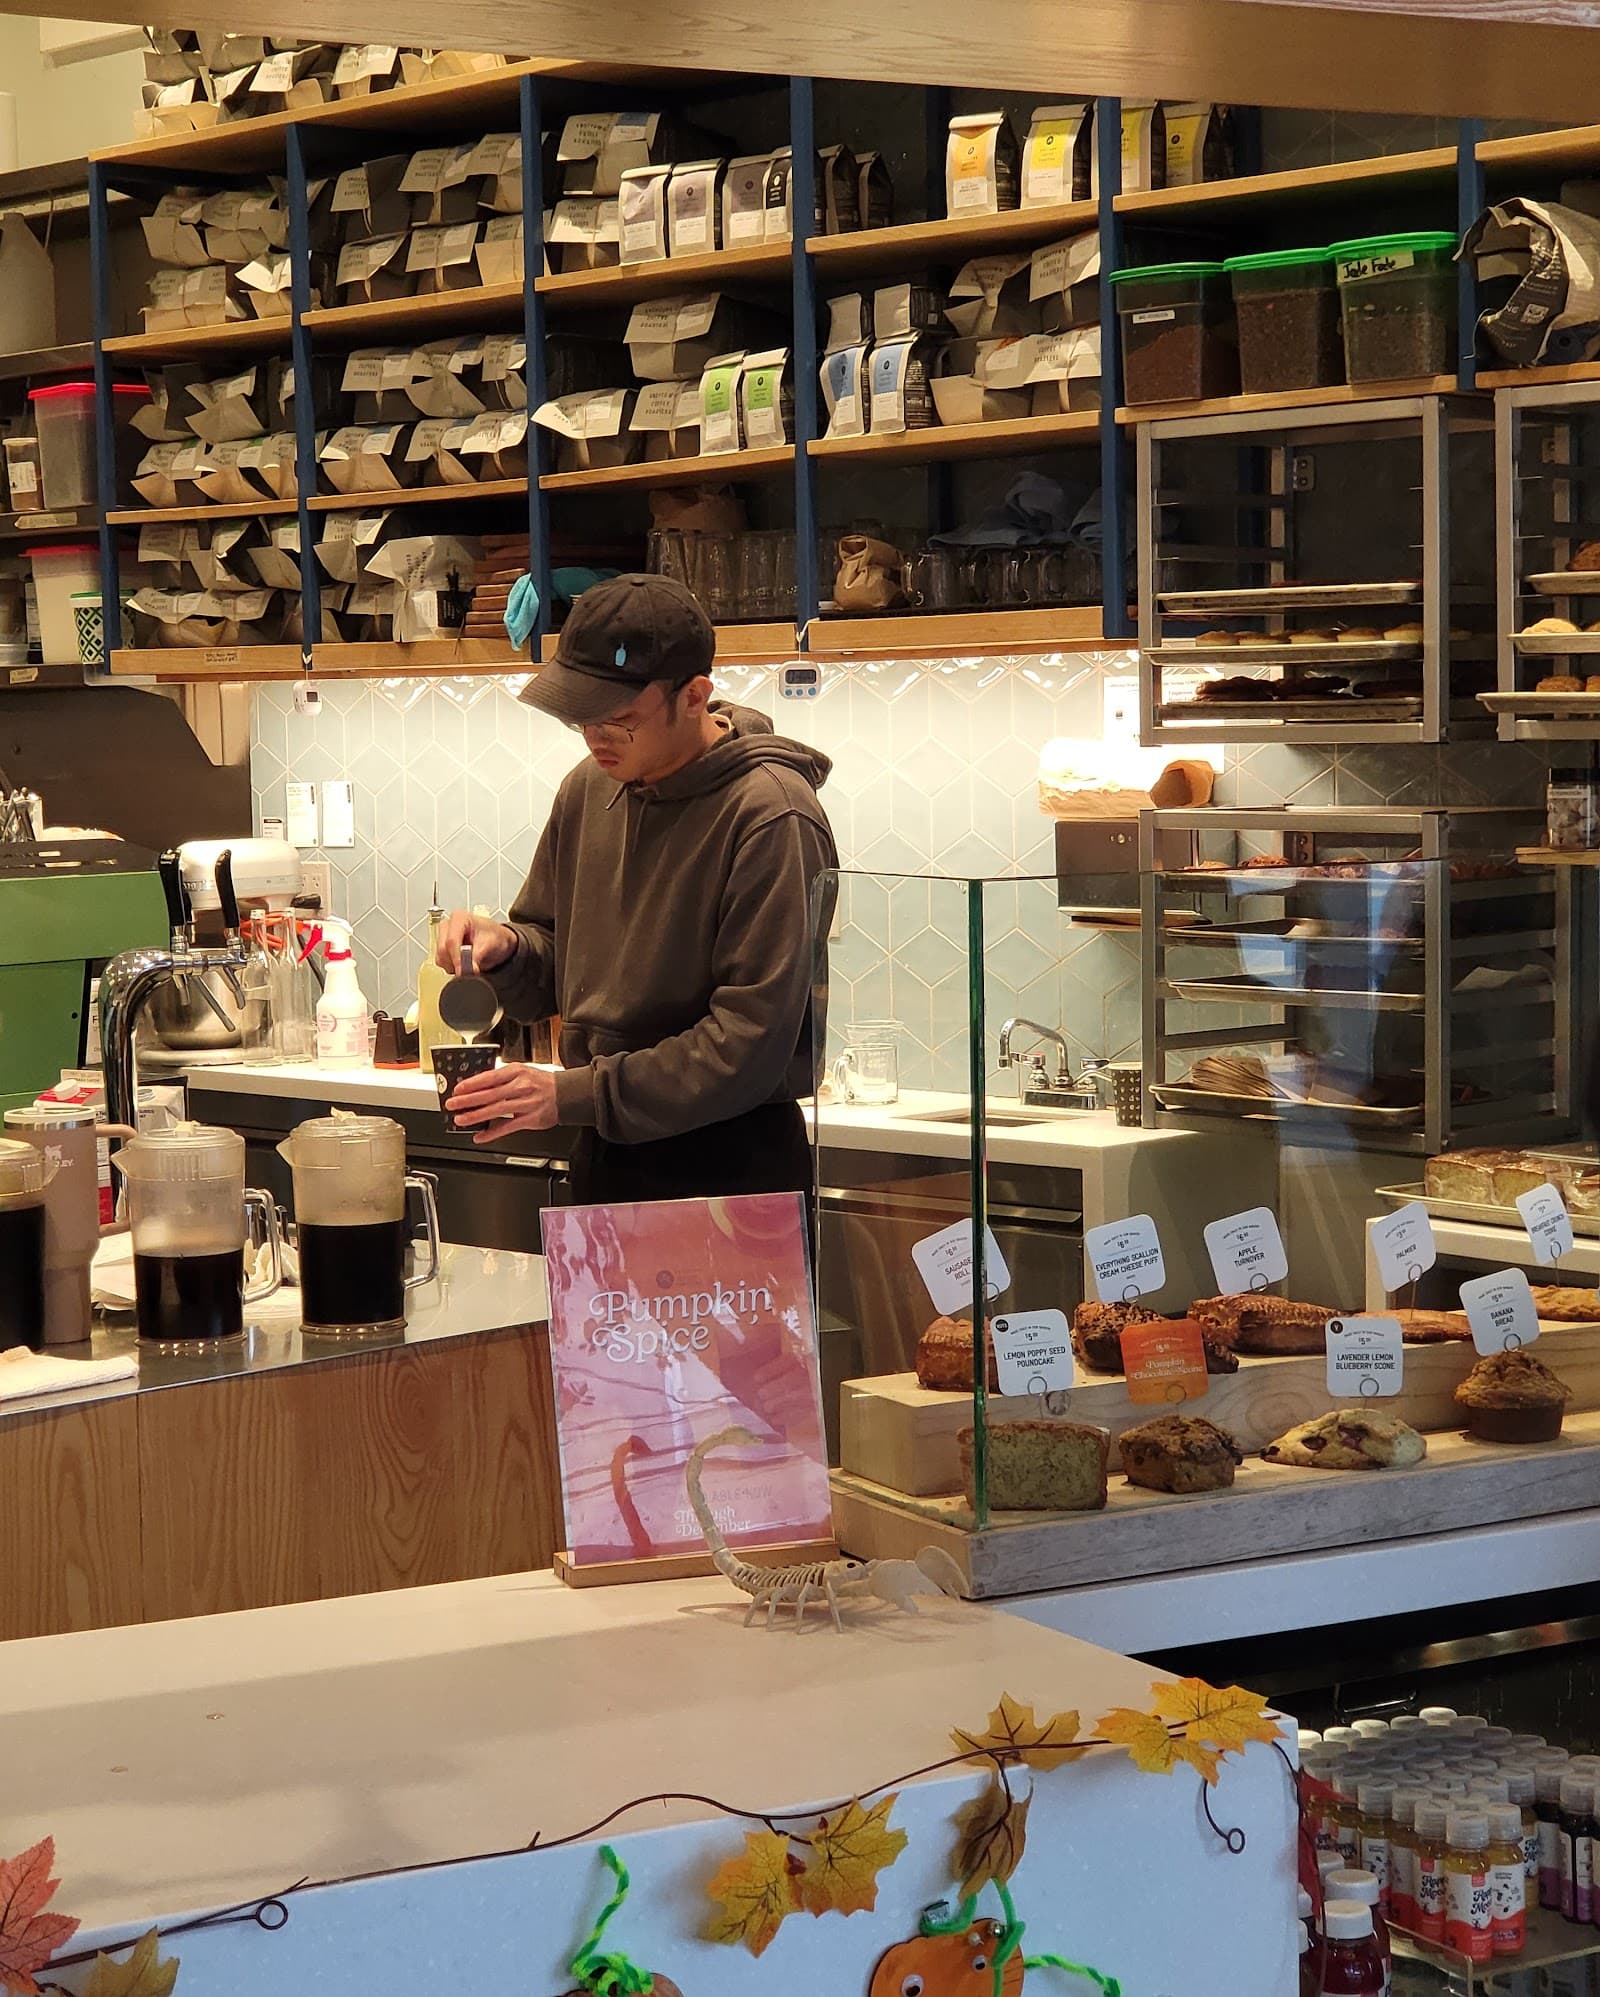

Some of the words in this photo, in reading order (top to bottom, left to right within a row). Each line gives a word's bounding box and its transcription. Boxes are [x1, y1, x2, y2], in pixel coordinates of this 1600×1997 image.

[1239, 1245, 1257, 1257] APPLE
[1396, 1243, 1417, 1259] PALMIER
[1096, 1255, 1130, 1271] EVERYTHING
[1131, 1248, 1159, 1261] SCALLION
[1234, 1252, 1265, 1267] TURNOVER
[954, 1268, 971, 1280] ROLL
[1100, 1268, 1119, 1280] CREAM
[1120, 1261, 1144, 1273] CHEESE
[1144, 1256, 1158, 1267] PUFF
[589, 1280, 773, 1325] Pumpkin
[1490, 1307, 1515, 1319] BANANA
[1494, 1315, 1514, 1327] BREAD
[592, 1320, 711, 1364] Spice
[1003, 1352, 1026, 1361] LEMON
[1027, 1348, 1048, 1358] POPPY
[1049, 1346, 1066, 1355] SEED
[1337, 1353, 1370, 1361] LAVENDER
[1371, 1353, 1394, 1361] LEMON
[1017, 1356, 1055, 1368] POUNDCAKE
[1336, 1362, 1372, 1370] BLUEBERRY
[1374, 1362, 1396, 1370] SCONE
